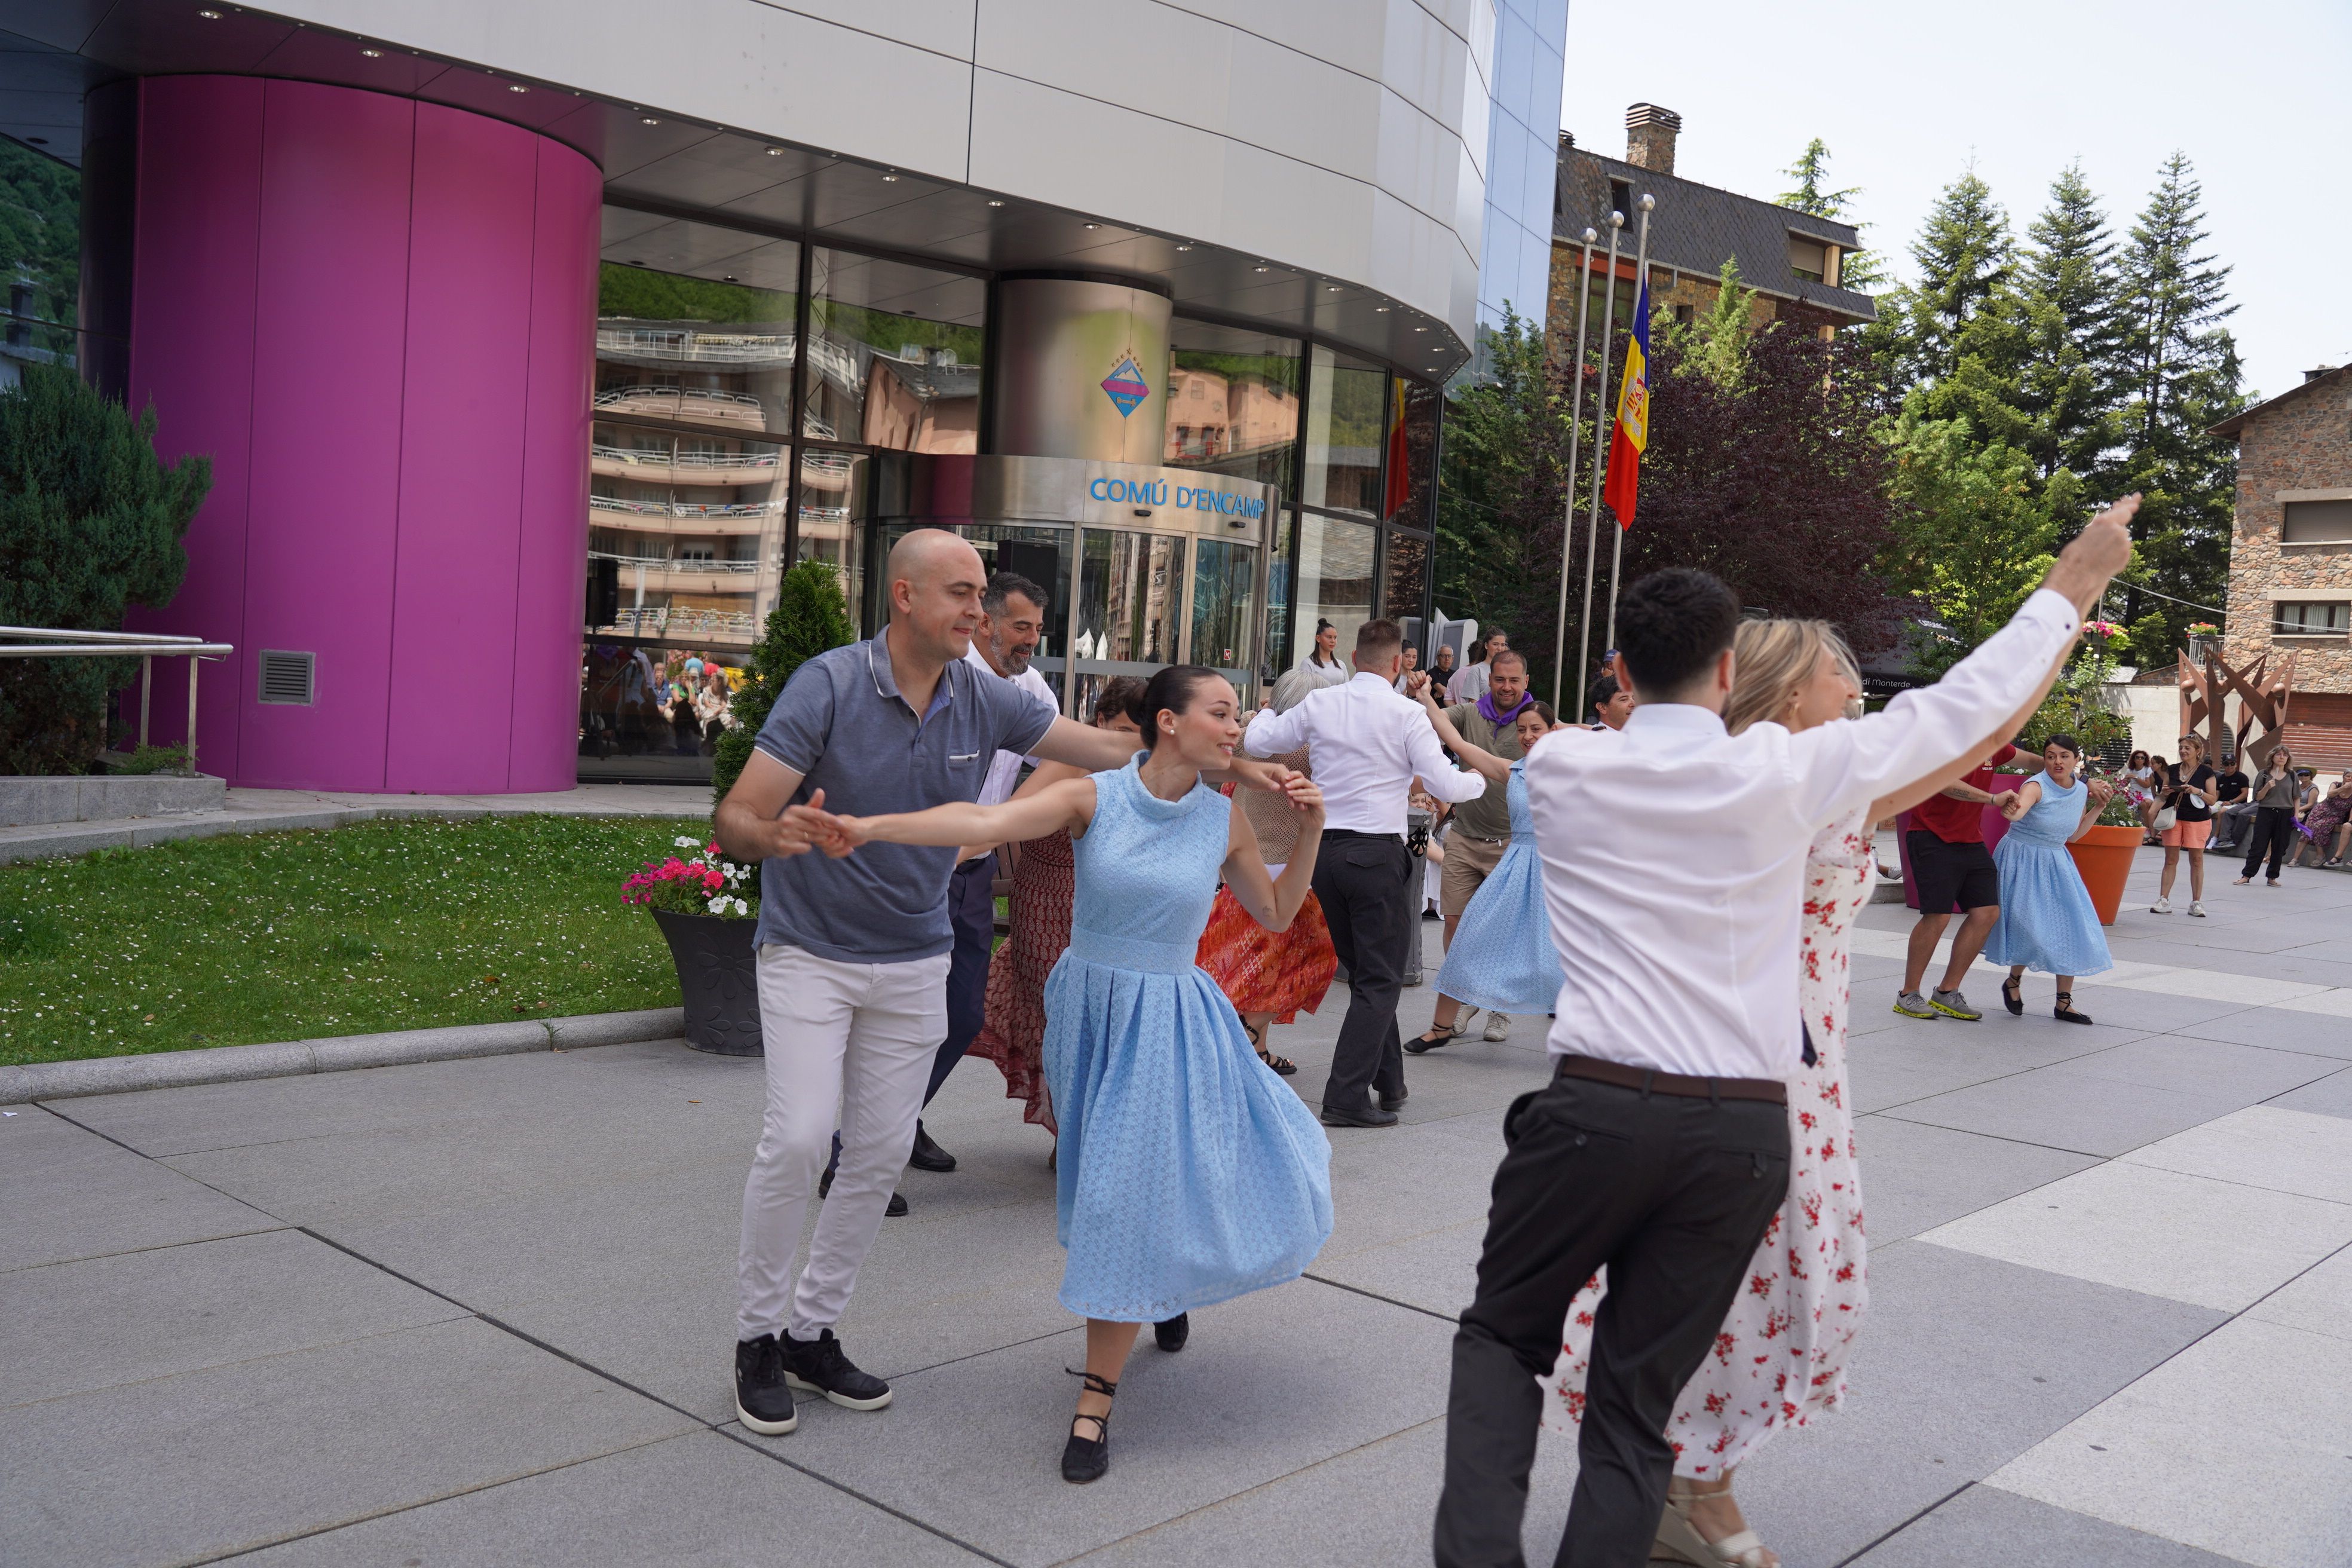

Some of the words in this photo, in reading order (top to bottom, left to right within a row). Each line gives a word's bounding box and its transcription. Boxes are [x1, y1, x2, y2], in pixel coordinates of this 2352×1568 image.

[1090, 477, 1168, 506] COMÚ
[1176, 486, 1265, 519] D'ENCAMP
[1872, 679, 1910, 688] Monterde
